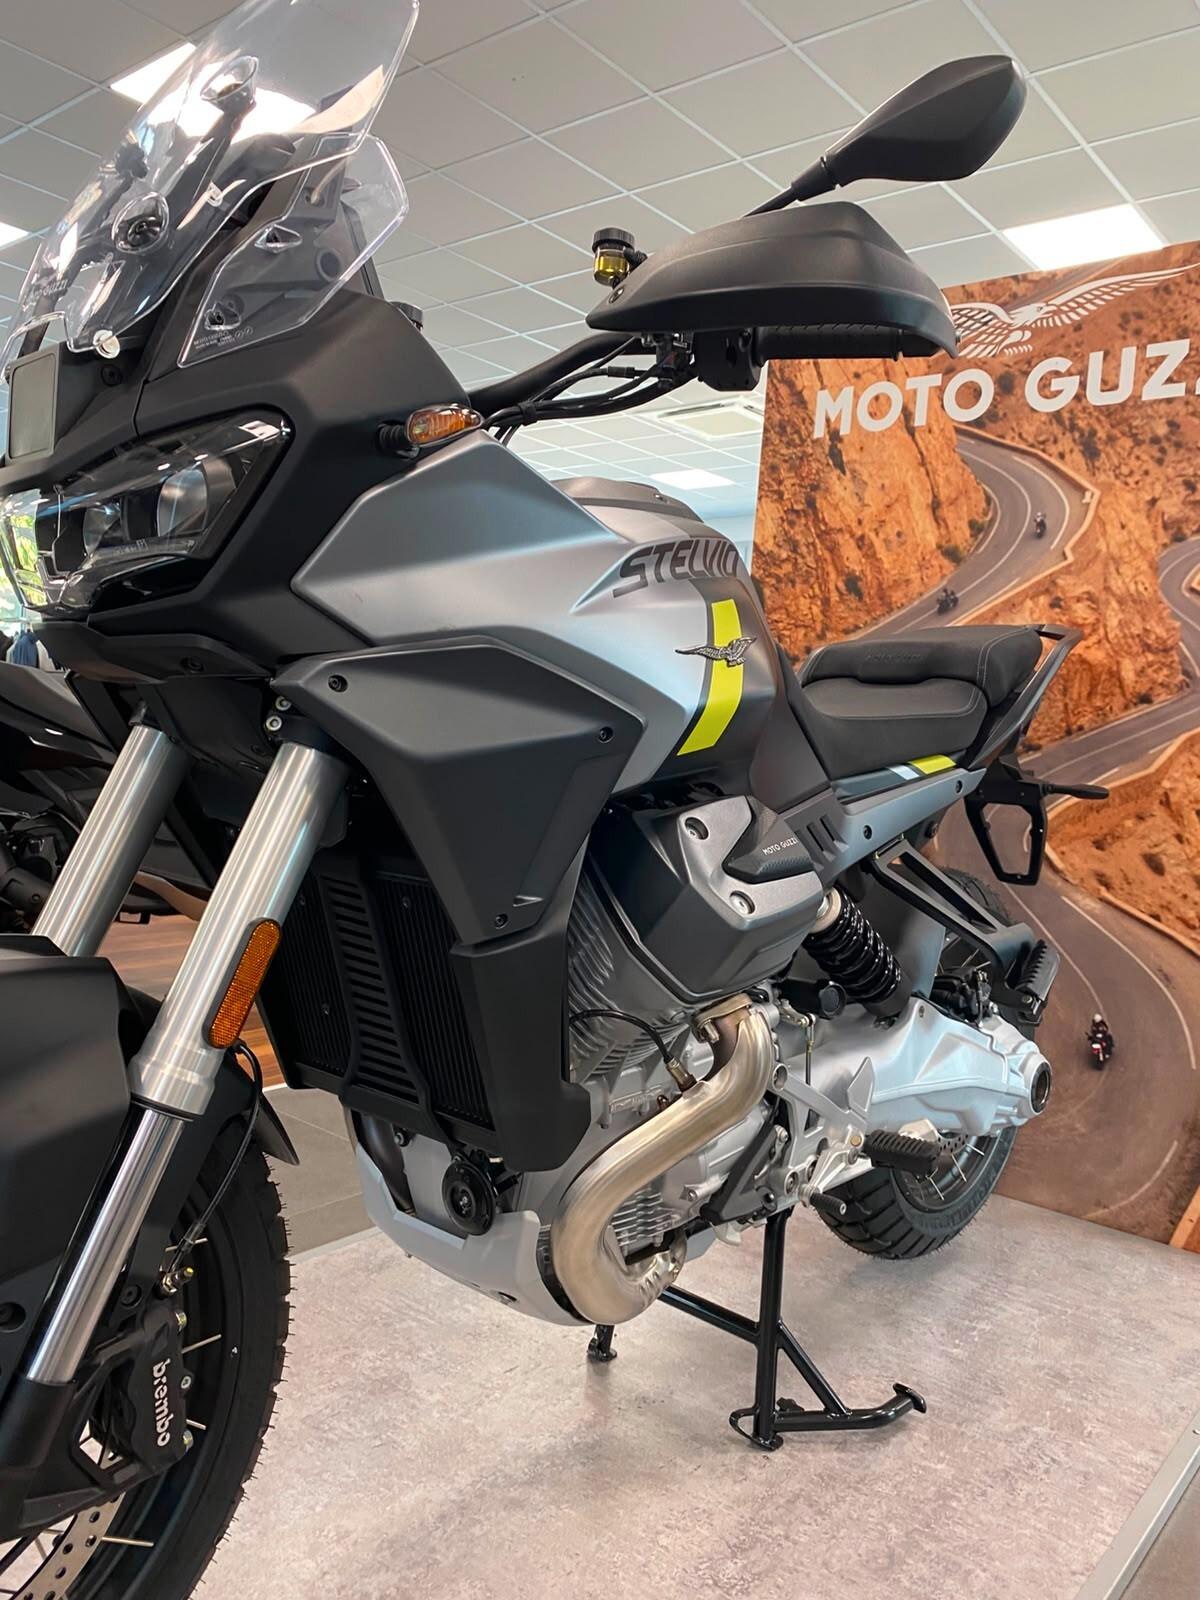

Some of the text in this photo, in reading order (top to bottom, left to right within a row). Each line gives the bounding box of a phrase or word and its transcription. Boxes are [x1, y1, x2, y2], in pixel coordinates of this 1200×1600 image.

[813, 338, 1200, 440] MOTO GUZ
[612, 539, 740, 599] STELVIO
[761, 843, 781, 856] MOTO
[152, 1358, 174, 1447] brembo
